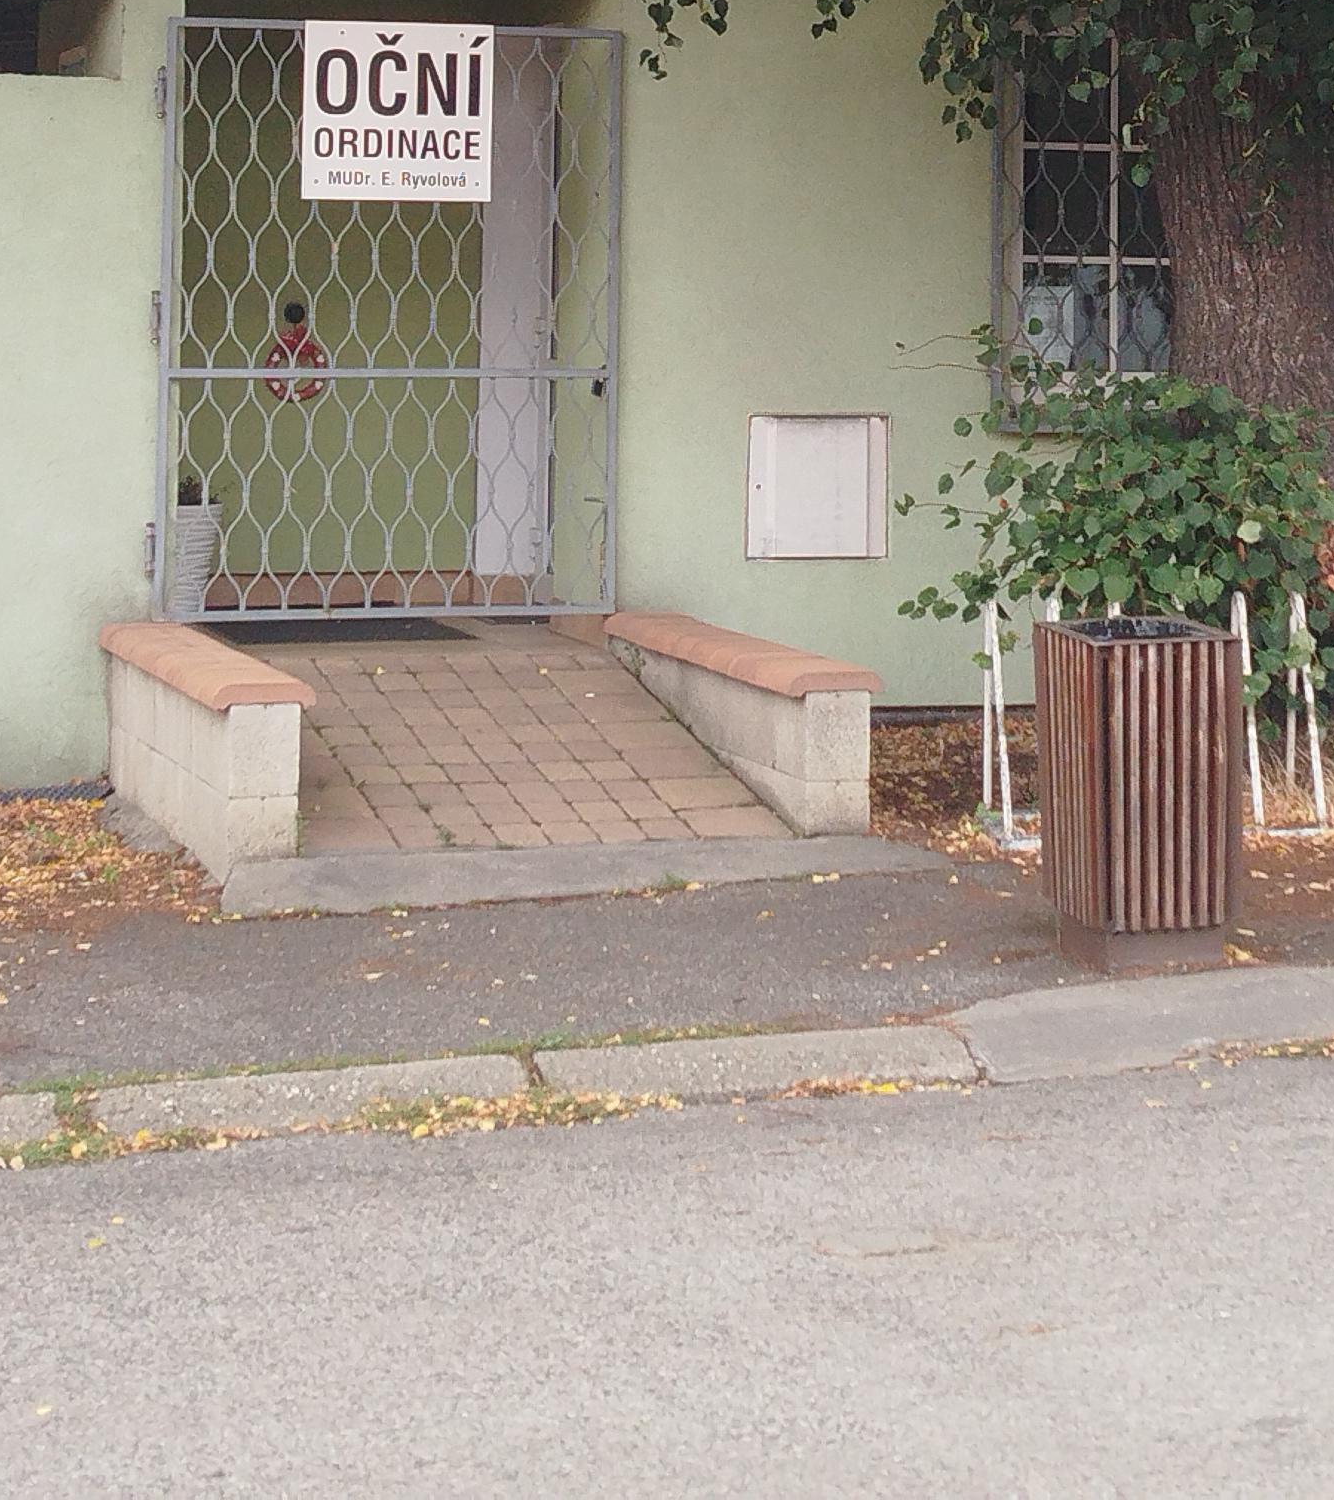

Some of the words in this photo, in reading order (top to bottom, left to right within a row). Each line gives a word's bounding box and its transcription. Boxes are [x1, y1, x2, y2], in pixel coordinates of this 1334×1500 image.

[316, 32, 489, 117] OČNÍ
[314, 127, 481, 161] ORDINACE
[328, 171, 375, 186] MUDr.
[381, 172, 395, 186] E.
[401, 171, 466, 190] Ryvolová
